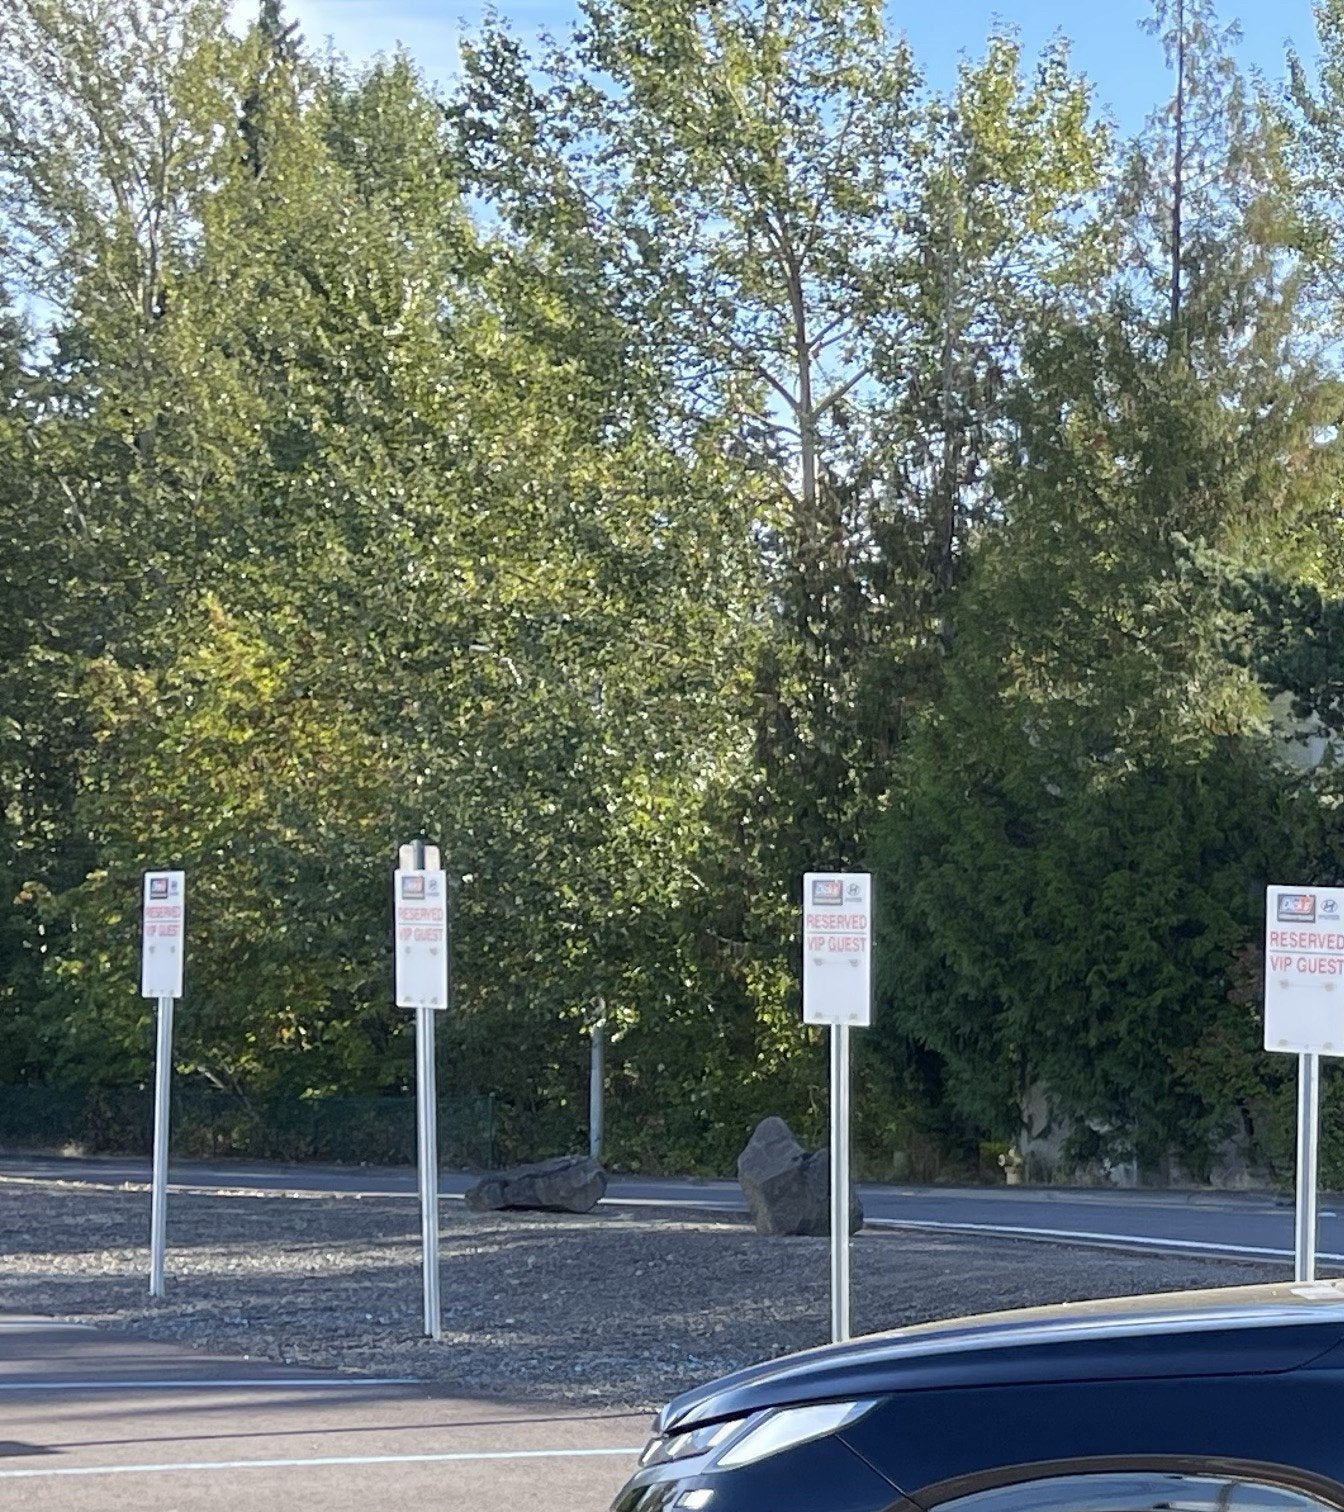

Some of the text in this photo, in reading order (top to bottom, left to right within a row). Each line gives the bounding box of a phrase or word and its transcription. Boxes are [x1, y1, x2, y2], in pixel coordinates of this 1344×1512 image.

[807, 914, 867, 929] RESERVED
[808, 936, 866, 952] VIP GUEST
[1270, 955, 1344, 975] VIP GUEST
